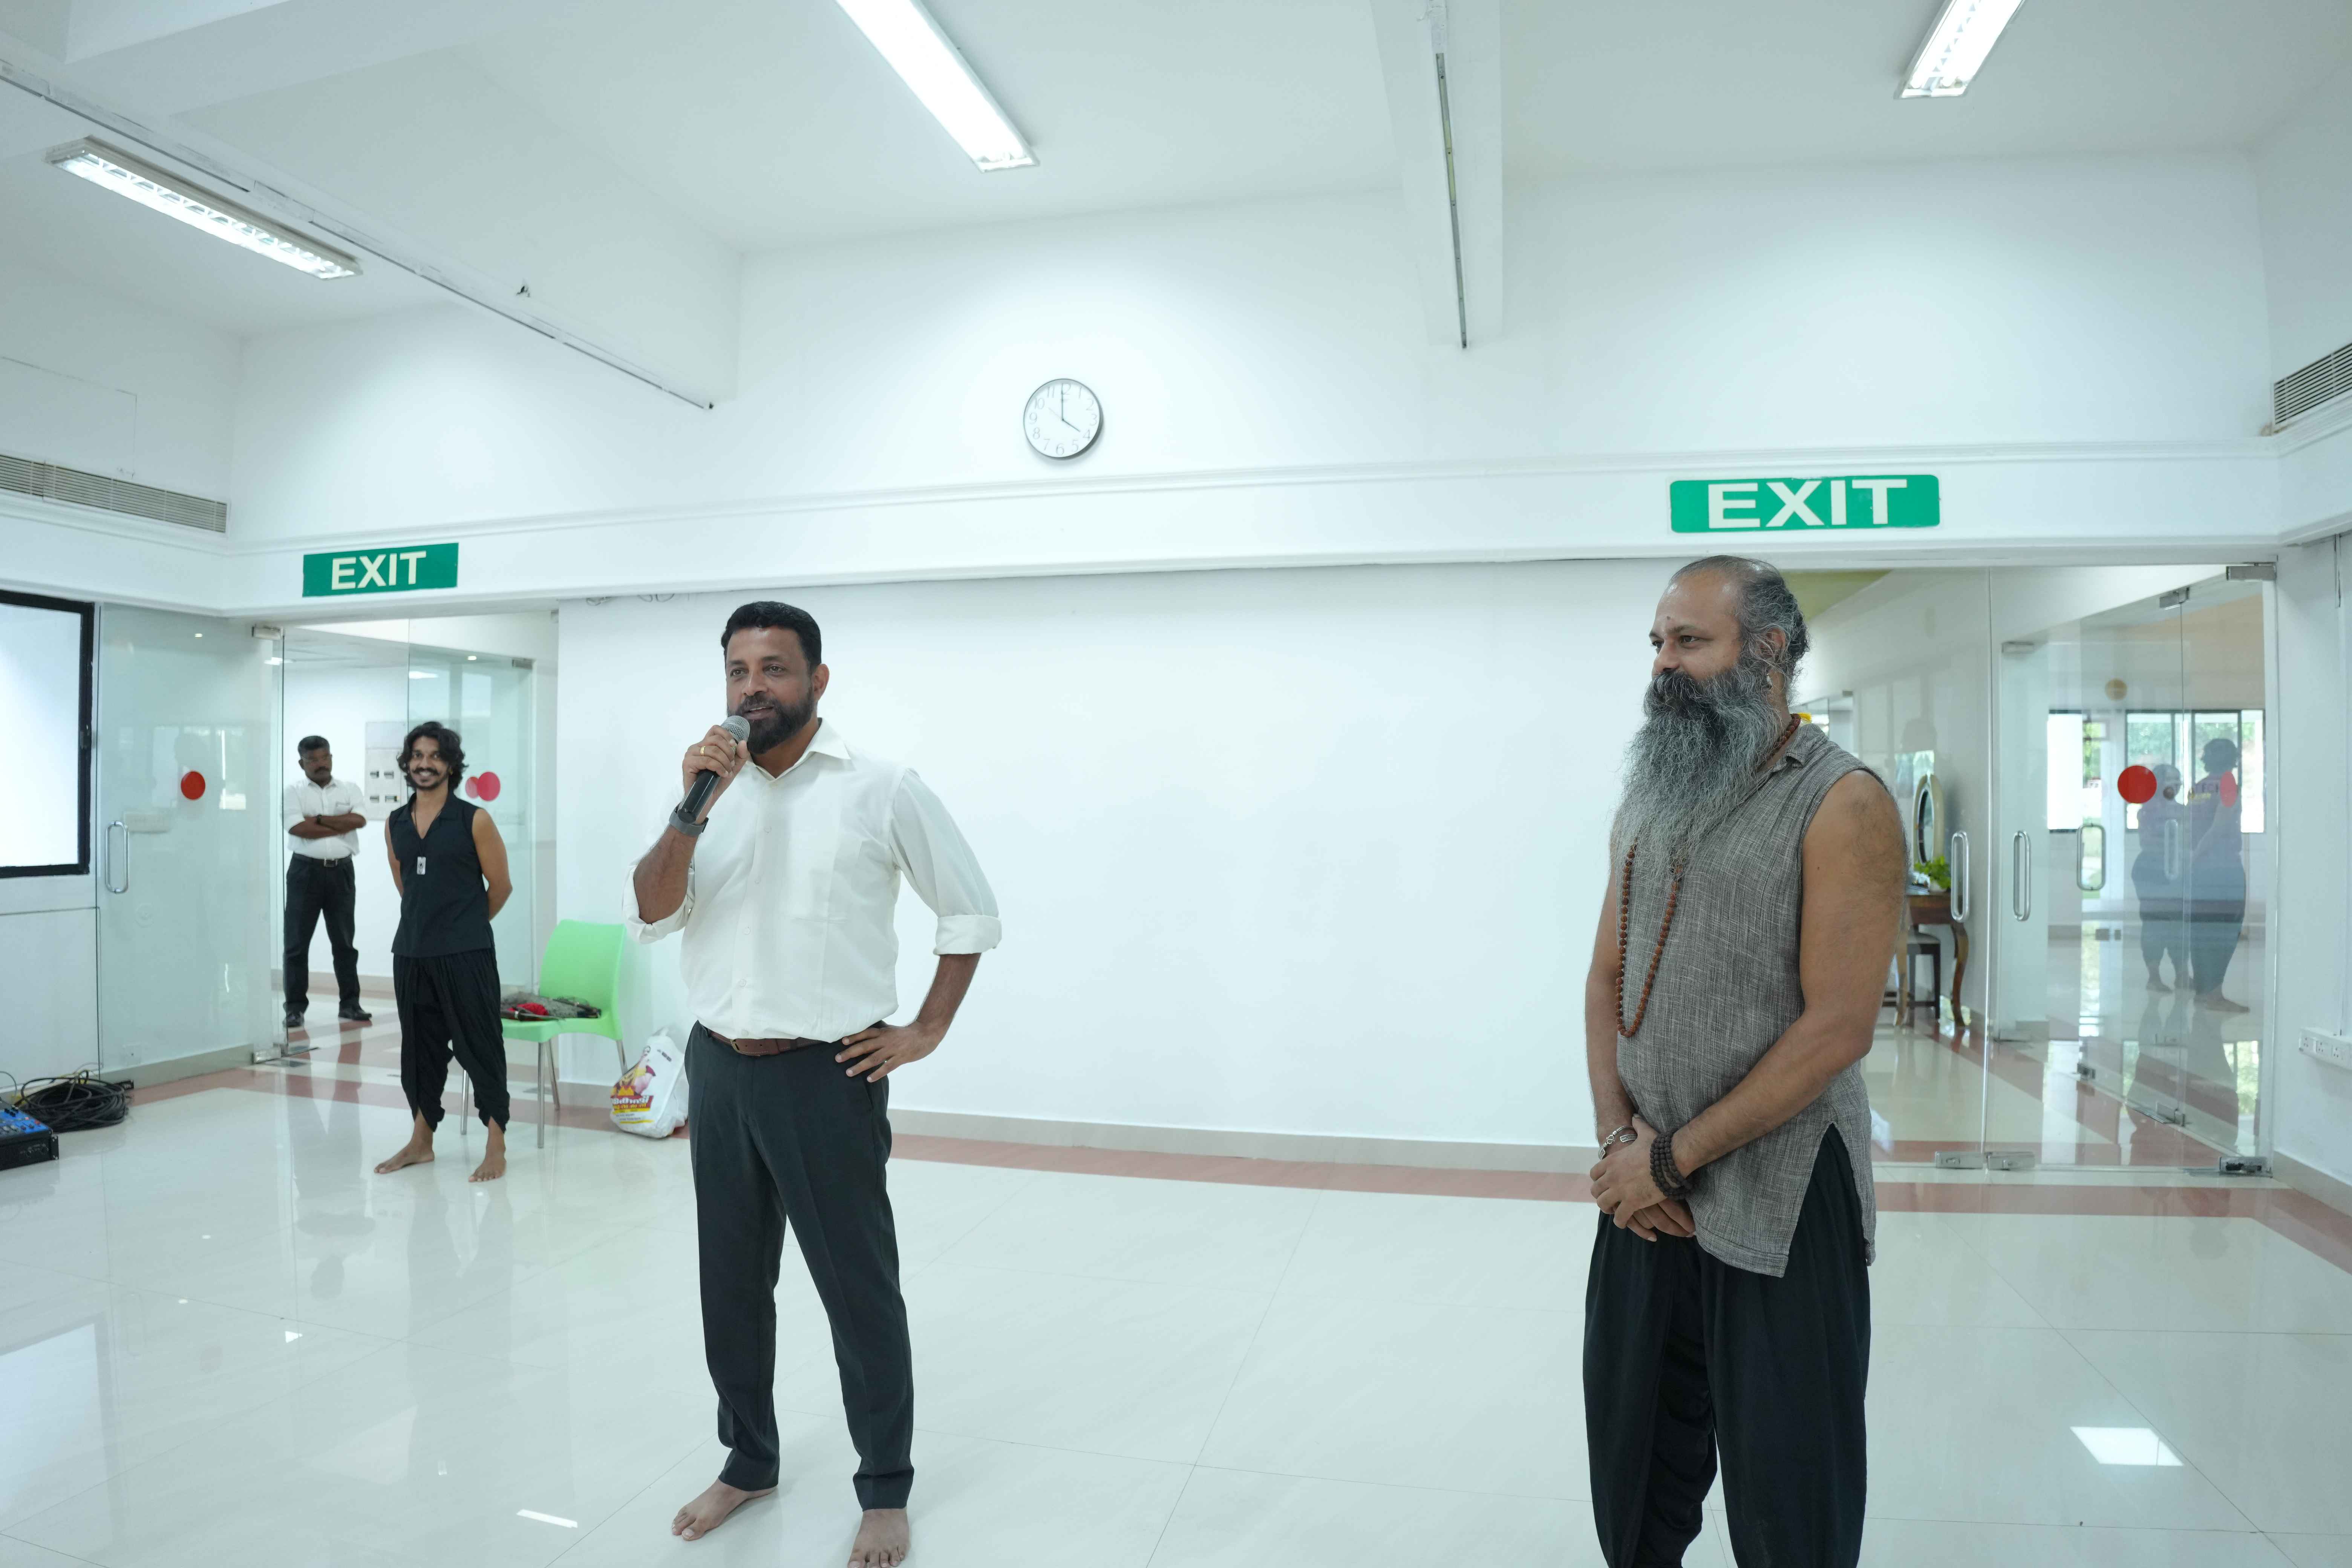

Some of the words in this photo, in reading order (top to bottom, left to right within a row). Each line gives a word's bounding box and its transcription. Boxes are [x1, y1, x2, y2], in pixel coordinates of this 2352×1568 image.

[1046, 386, 1055, 398] 11
[1079, 386, 1082, 398] 1
[1034, 398, 1044, 409] 10
[1086, 398, 1094, 411] 2
[1029, 412, 1037, 424] 9
[1090, 413, 1097, 426] 3
[1033, 427, 1040, 439] 8
[1083, 429, 1090, 441] 4
[1043, 439, 1050, 450] 7
[1056, 443, 1064, 455] 6
[1071, 439, 1079, 452] 5
[1708, 479, 1907, 528] EXIT
[331, 551, 426, 590] EXIT
